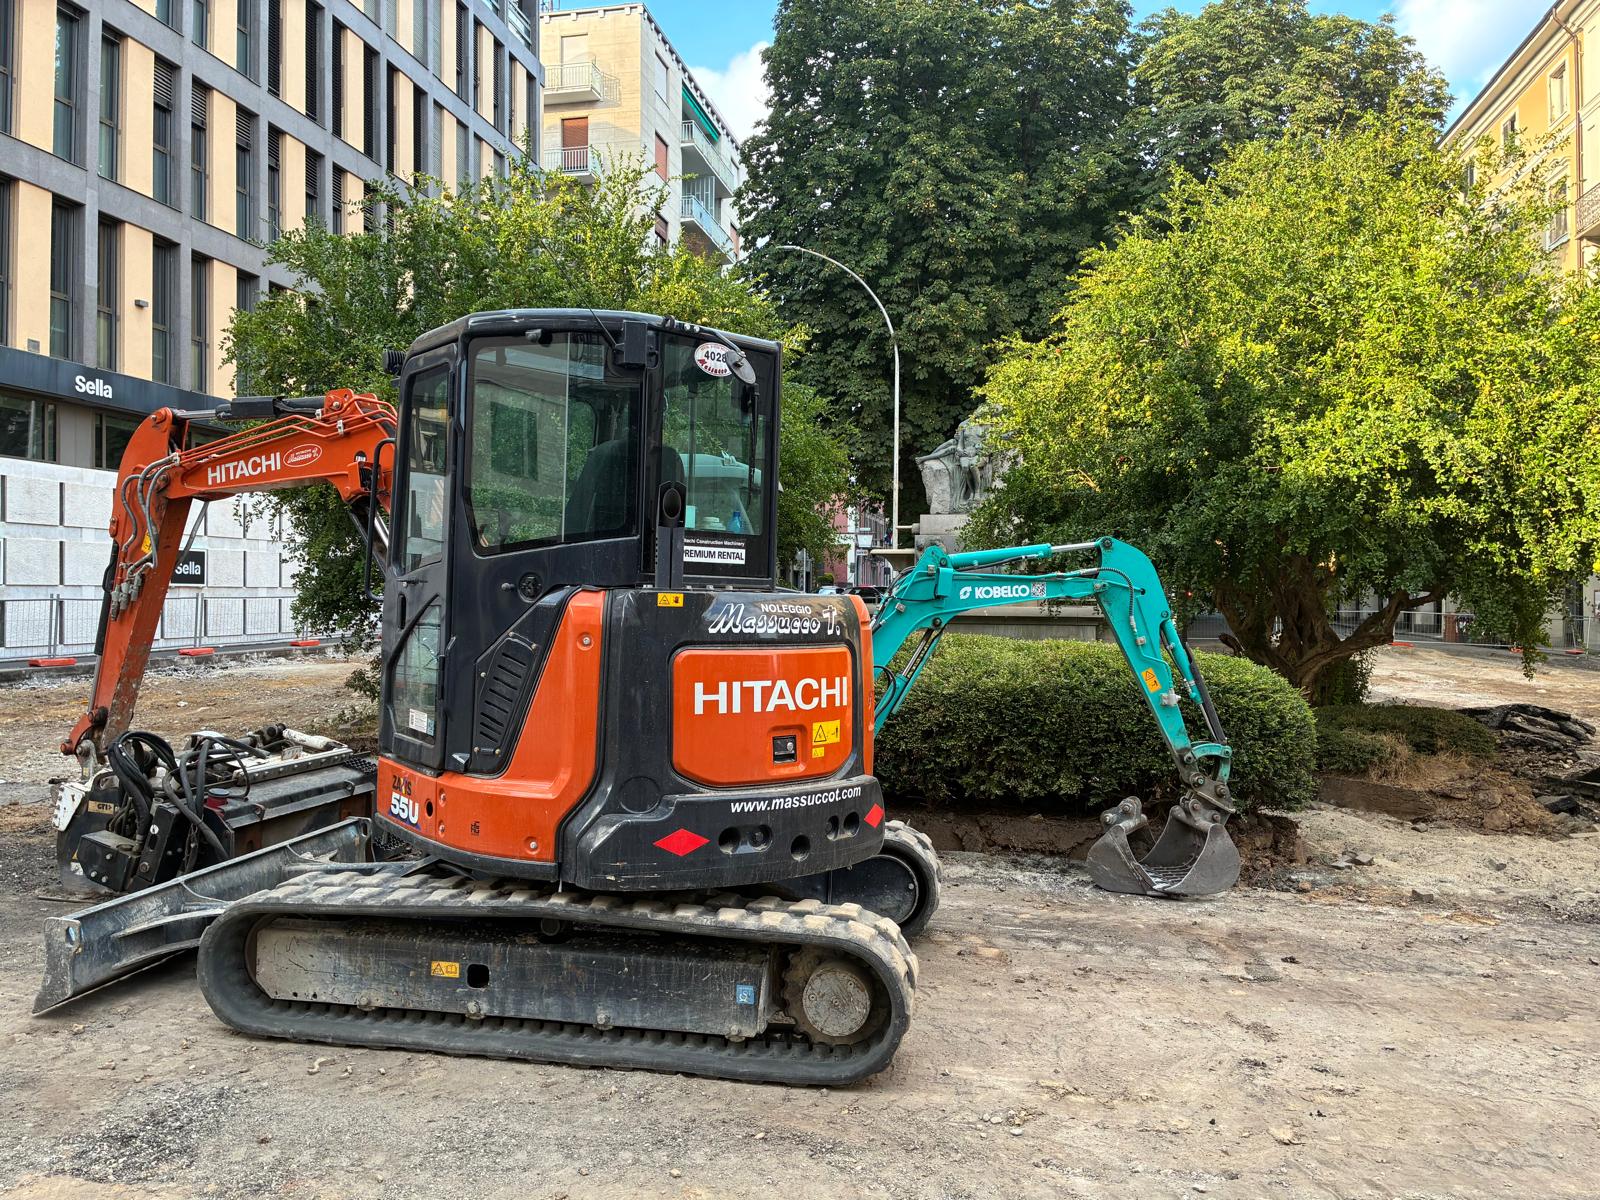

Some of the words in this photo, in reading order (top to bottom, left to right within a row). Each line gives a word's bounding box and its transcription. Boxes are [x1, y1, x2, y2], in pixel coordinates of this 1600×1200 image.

[75, 375, 113, 399] Sella
[207, 452, 281, 485] HITACHI
[684, 549, 716, 558] REMIUM
[717, 551, 744, 560] RENTAL
[174, 561, 201, 576] Sella
[974, 584, 1030, 600] KOBELCO
[708, 603, 821, 635] Massucco
[822, 605, 841, 636] T.
[760, 603, 813, 615] NOLEGGIO
[694, 676, 848, 715] HITACHI
[390, 791, 419, 825] 55U
[730, 786, 862, 813] www.massuccot.com
